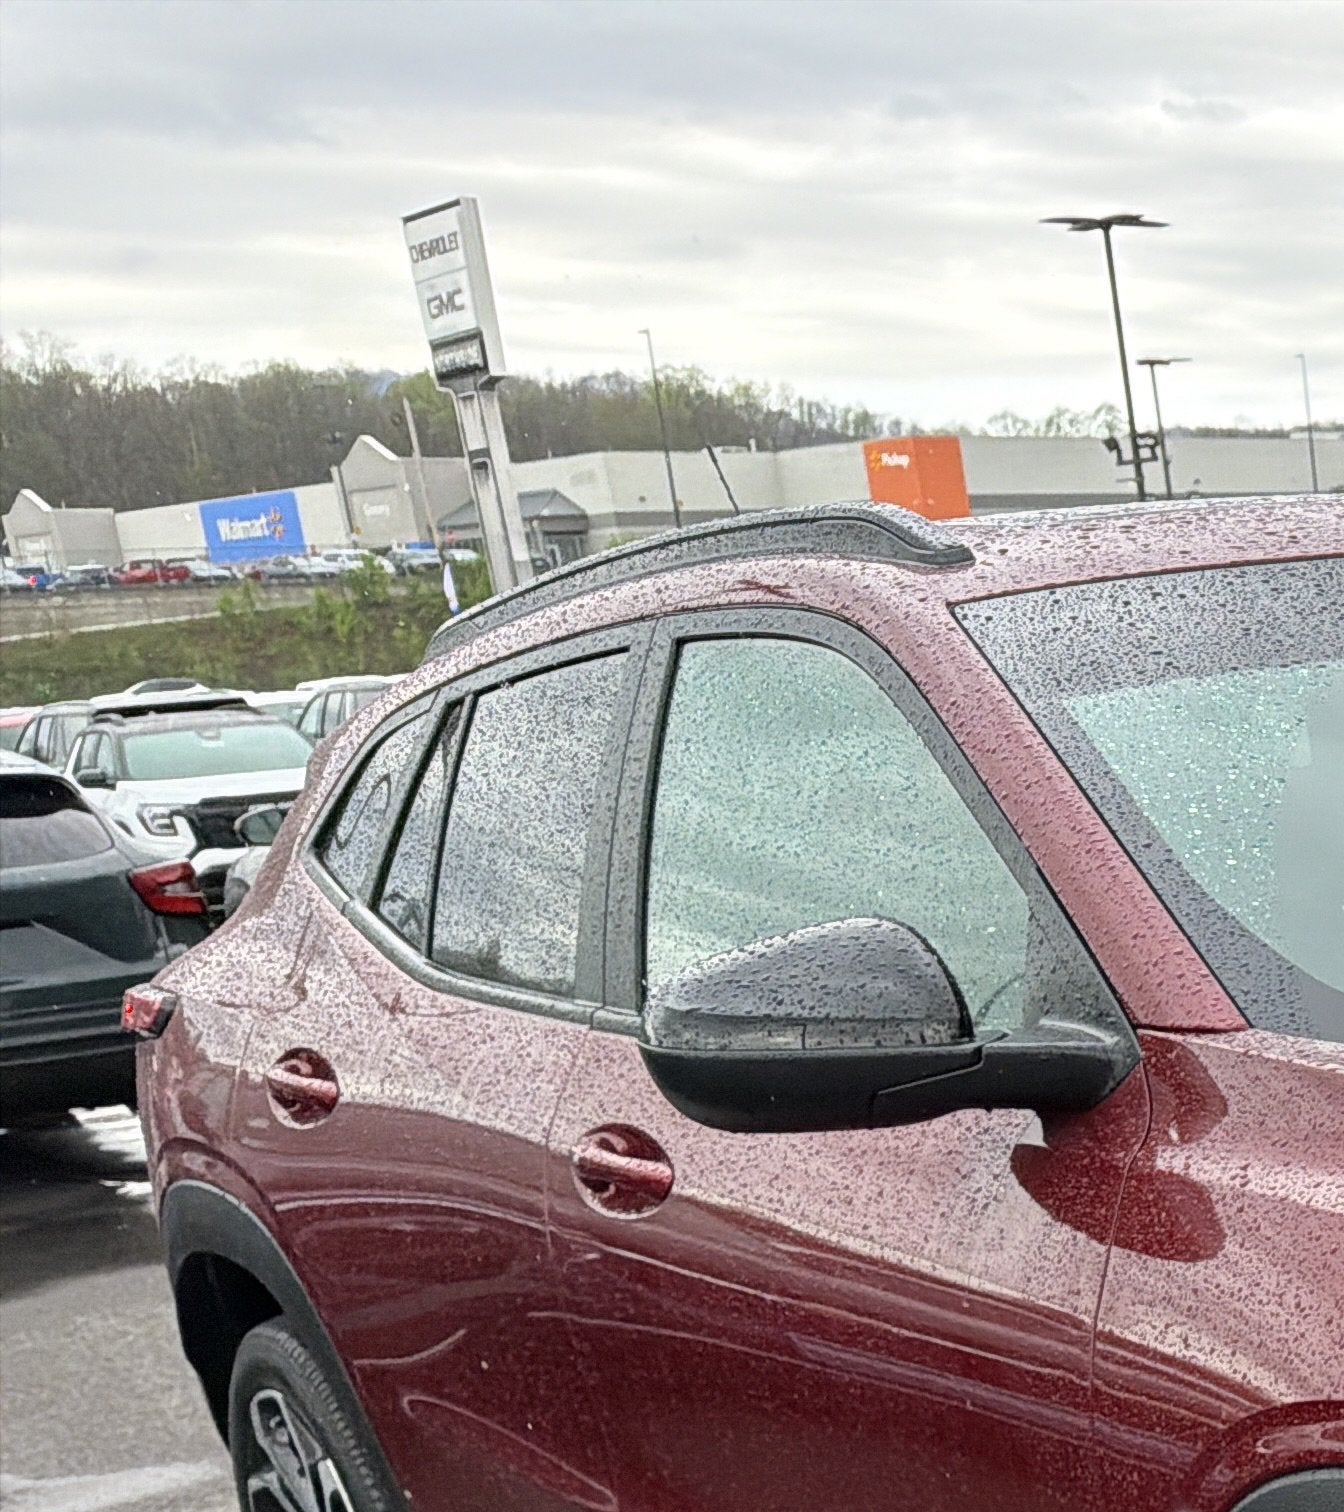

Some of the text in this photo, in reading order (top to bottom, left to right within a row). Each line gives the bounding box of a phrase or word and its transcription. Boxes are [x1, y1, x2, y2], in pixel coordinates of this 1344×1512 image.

[408, 231, 459, 263] CHEVROLET
[426, 287, 465, 319] GMC
[216, 513, 270, 542] Walmart
